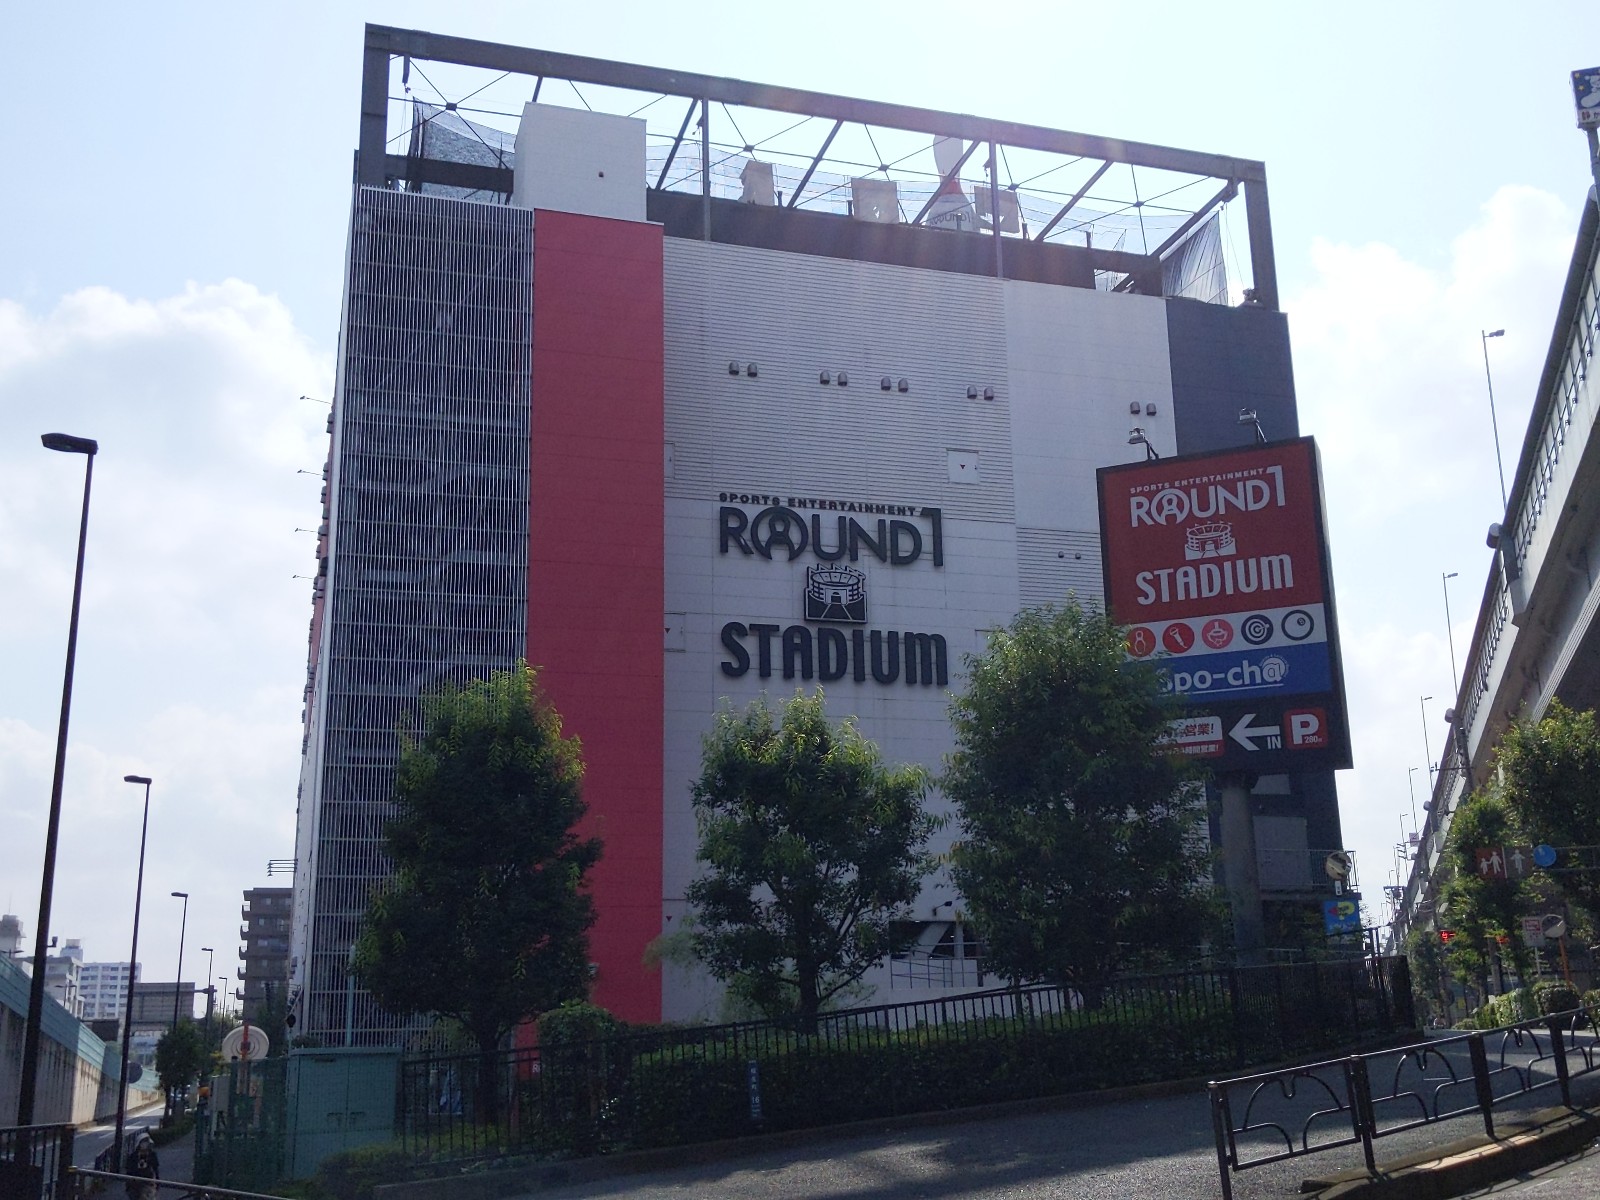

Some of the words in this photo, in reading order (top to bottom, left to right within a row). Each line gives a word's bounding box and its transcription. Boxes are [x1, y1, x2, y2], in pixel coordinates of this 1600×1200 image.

[1129, 481, 1171, 494] SPORTS
[1174, 468, 1264, 487] ENTERTAINMENT
[719, 492, 781, 506] SPORTS
[788, 497, 916, 517] ENTERTAINMENT
[1130, 465, 1285, 528] ROUND1
[719, 506, 944, 567] ROUND1
[1267, 735, 1282, 749] IN
[1291, 713, 1319, 744] P
